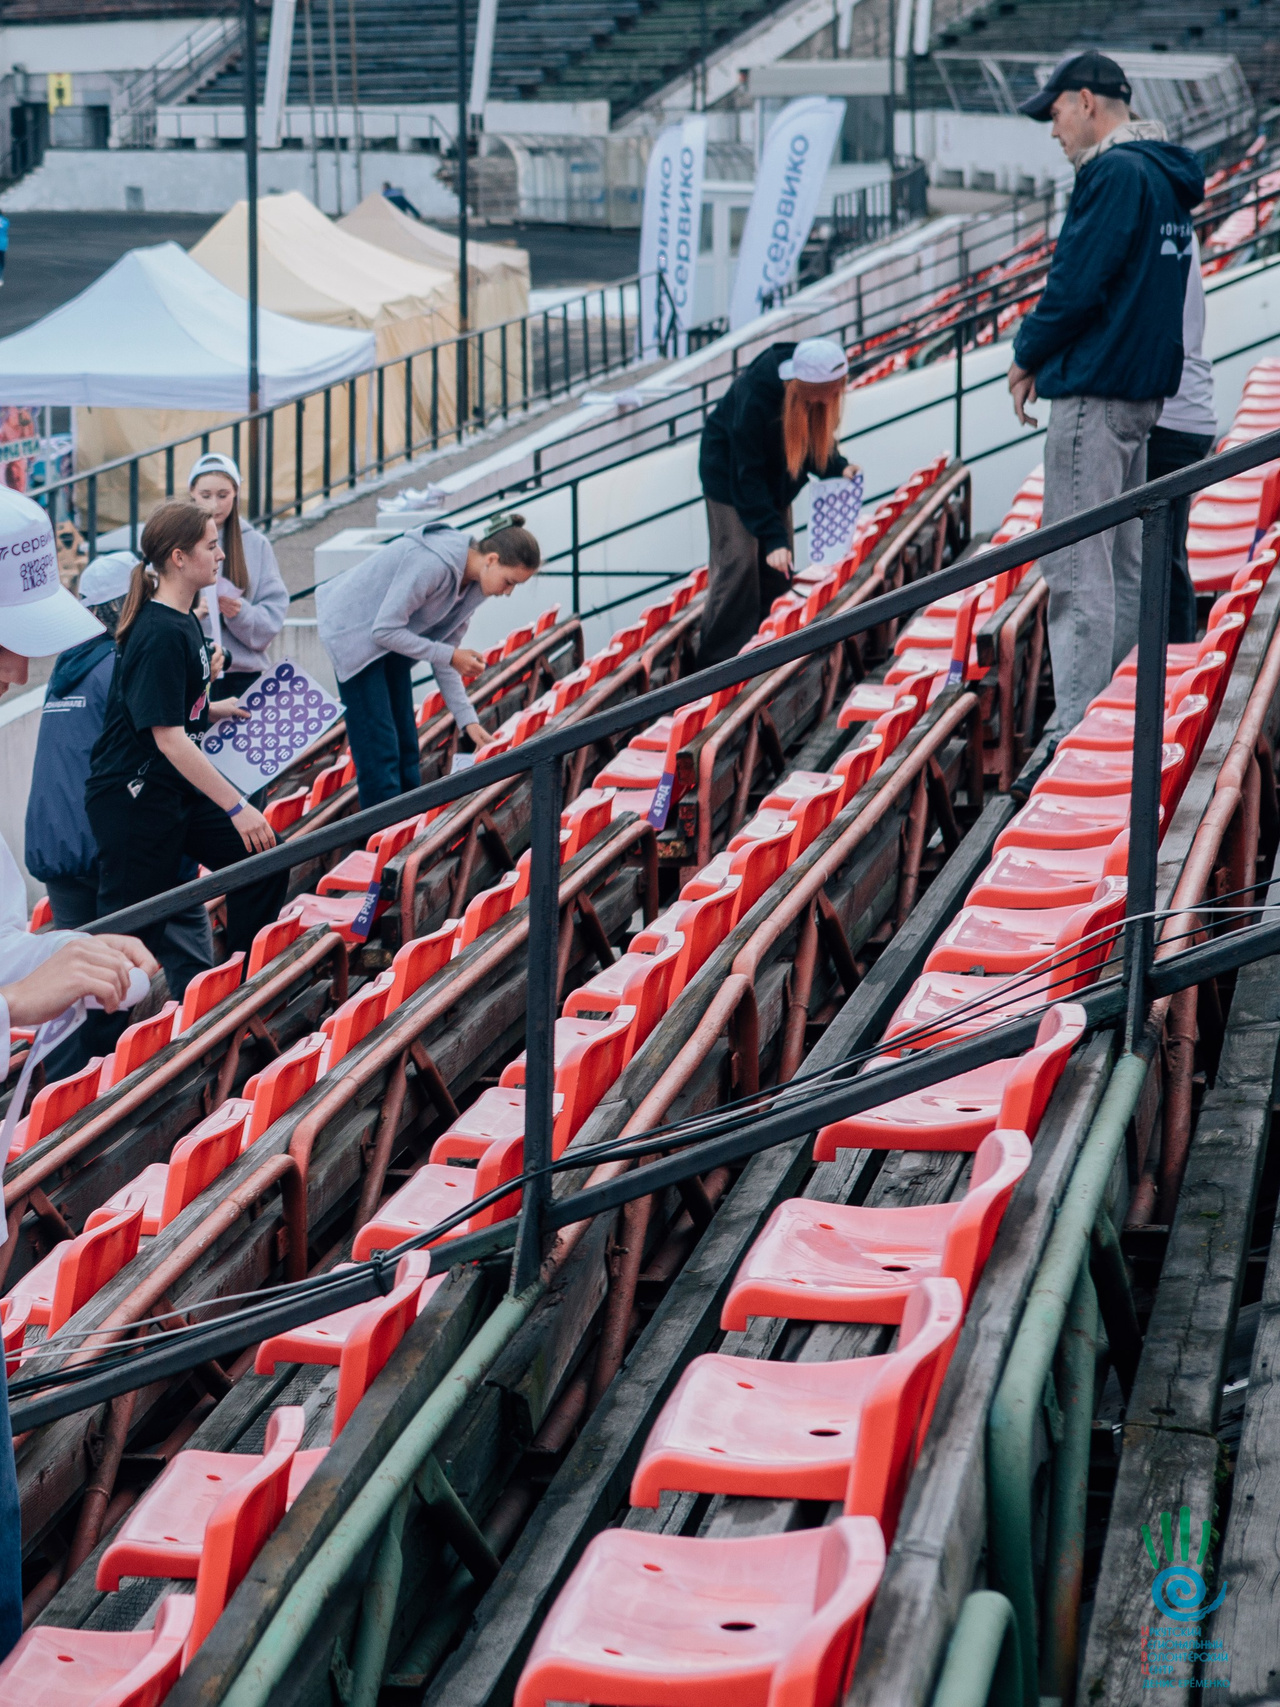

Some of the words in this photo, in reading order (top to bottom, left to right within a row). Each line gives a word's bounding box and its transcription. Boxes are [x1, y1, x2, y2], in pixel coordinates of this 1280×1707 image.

[674, 147, 695, 308] сервико
[266, 682, 276, 692] 5
[280, 695, 289, 705] 6
[294, 709, 304, 718] 7
[308, 721, 318, 731] 8
[282, 669, 289, 678] 1
[293, 681, 304, 692] 2
[308, 694, 318, 704] 3
[323, 708, 333, 717] 4
[252, 697, 261, 706] 9
[264, 709, 277, 721] 10
[279, 723, 291, 734] 11
[292, 735, 305, 747] 12
[207, 739, 220, 752] 21
[222, 725, 235, 736] 17
[235, 737, 248, 749] 18
[249, 750, 262, 762] 19
[261, 761, 275, 774] 20
[250, 723, 263, 735] 14
[264, 736, 277, 748] 15
[278, 748, 290, 760] 16
[653, 808, 663, 817] 4
[655, 784, 671, 808] РЯД
[358, 915, 368, 924] 3
[360, 893, 377, 916] РЯД
